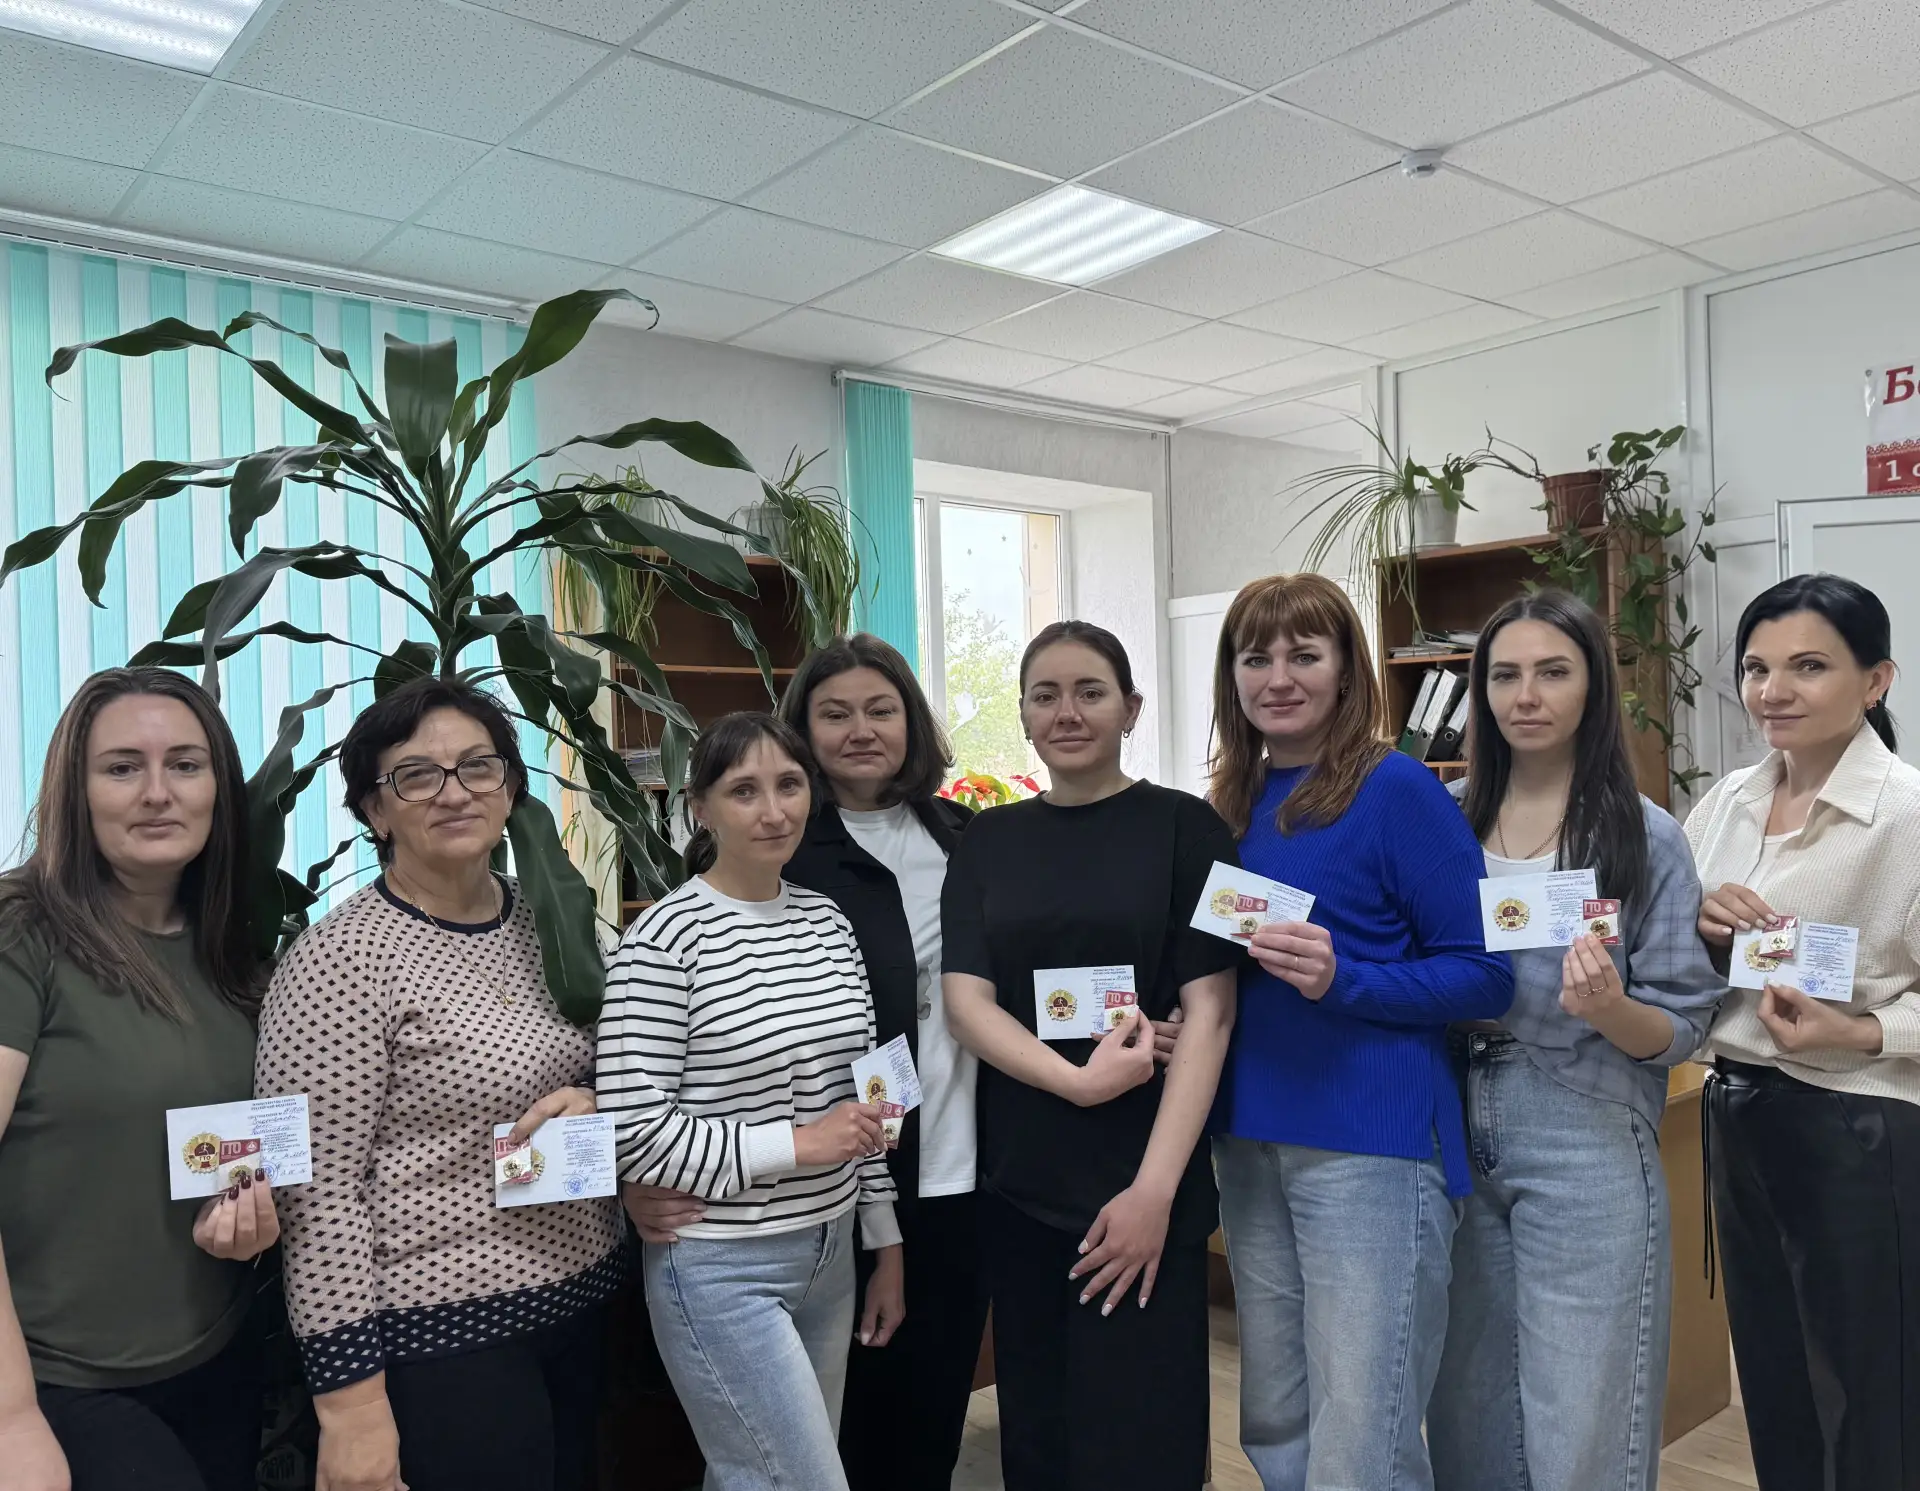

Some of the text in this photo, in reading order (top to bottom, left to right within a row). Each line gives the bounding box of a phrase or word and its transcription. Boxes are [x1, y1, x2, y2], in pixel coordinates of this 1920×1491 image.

[1883, 365, 1920, 405] Б
[1886, 459, 1902, 482] 1
[1583, 901, 1602, 913] ГТО
[221, 1141, 242, 1156] ГТО
